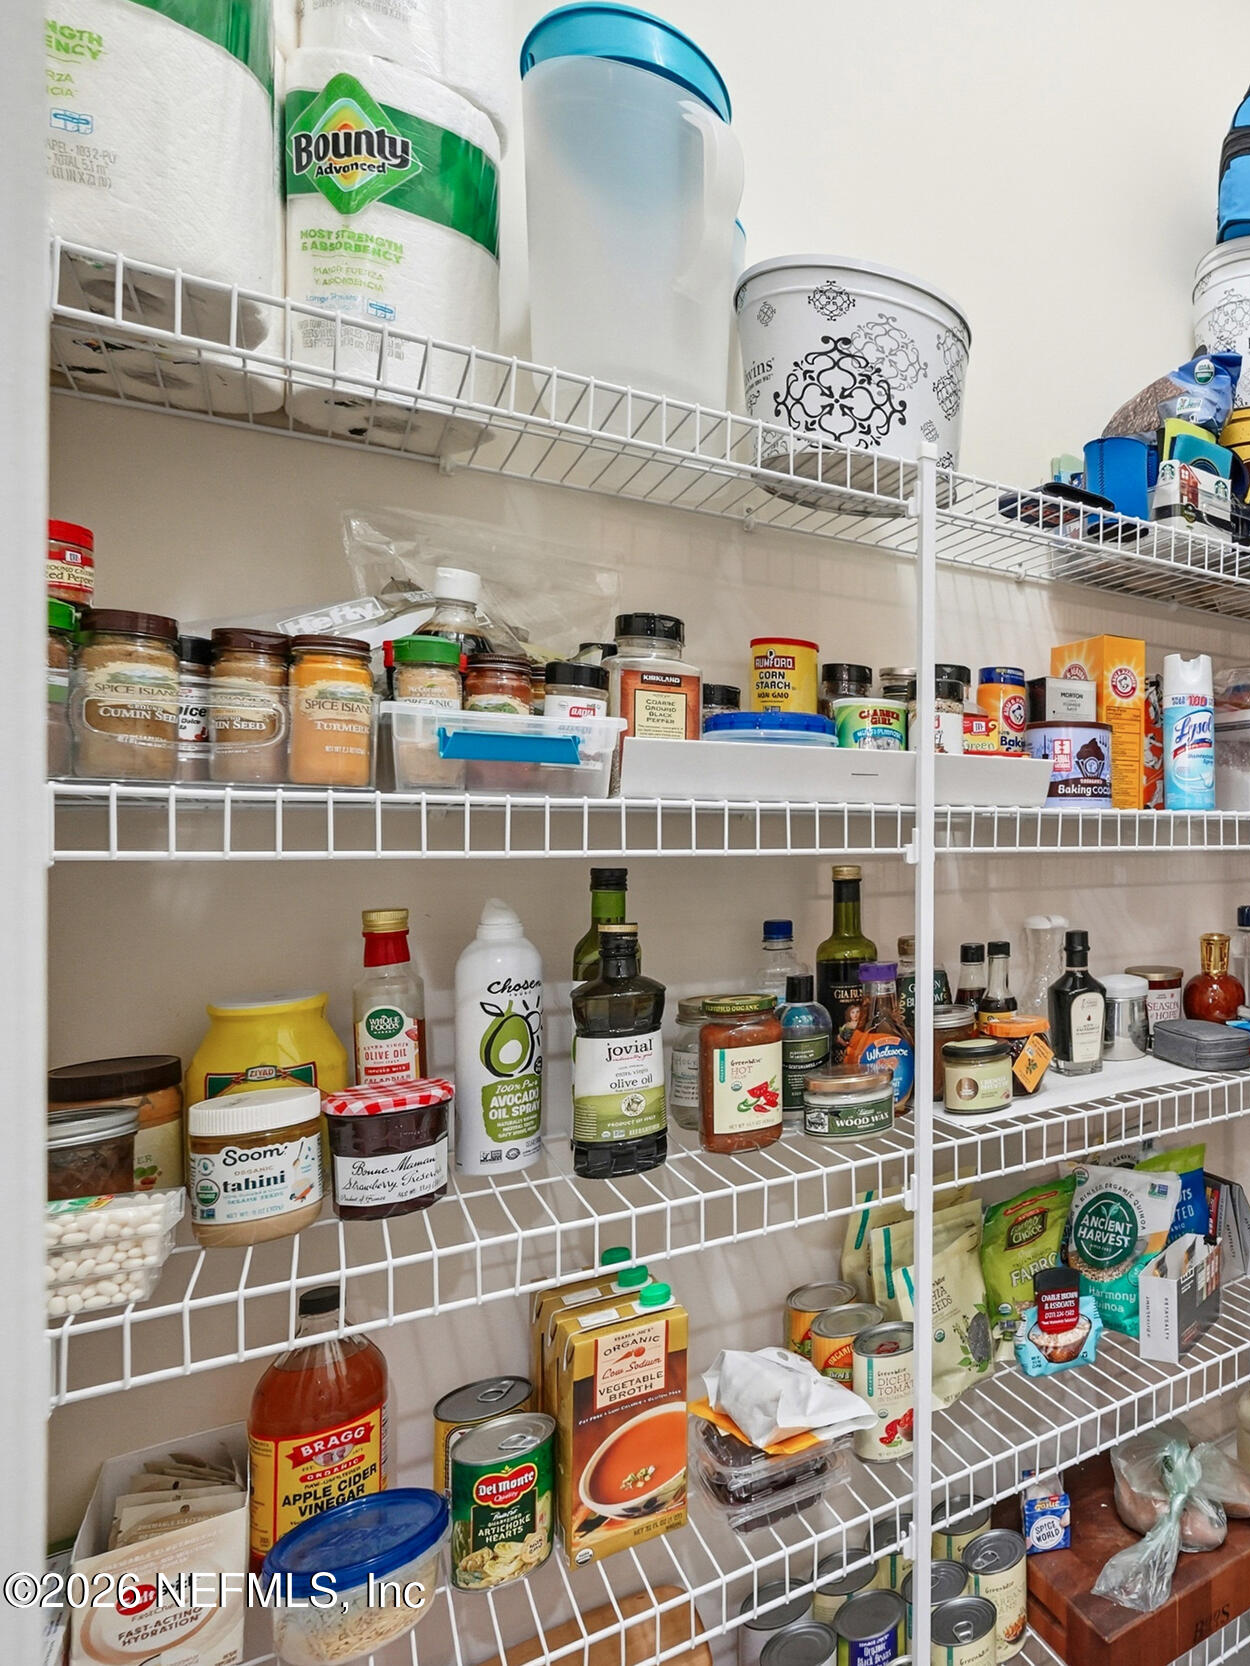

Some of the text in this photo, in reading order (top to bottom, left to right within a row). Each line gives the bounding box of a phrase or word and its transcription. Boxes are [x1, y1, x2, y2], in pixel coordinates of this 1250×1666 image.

[292, 127, 412, 175] Bounty
[315, 161, 388, 178] Advanced
[301, 228, 404, 254] MOST STRENGTH
[310, 240, 405, 264] ABSORBENCY
[754, 656, 795, 669] RUMFORD
[642, 674, 682, 684] KIRKLAND
[758, 671, 785, 681] CORN
[94, 682, 135, 694] SPICE
[755, 681, 791, 691] STARCH
[304, 698, 340, 711] SPICE
[645, 699, 677, 707] COARSE
[1060, 692, 1084, 700] MORTON
[99, 705, 151, 719] CUMIN
[645, 705, 677, 714] GROUND
[232, 719, 267, 731] SEED
[645, 717, 676, 725] PEPPER
[870, 715, 893, 726] GIRL
[1174, 713, 1214, 743] Lysol
[1057, 784, 1092, 796] Baking
[487, 978, 541, 995] Chosen
[1146, 1001, 1179, 1011] SEASON
[369, 1015, 400, 1026] WHOLE
[1155, 1010, 1178, 1020] HOPE
[370, 1022, 399, 1031] FOODS
[364, 1047, 407, 1061] OLIVE OIL
[605, 1038, 653, 1062] jovial
[249, 1067, 274, 1077] ZIYAD
[730, 1065, 754, 1075] HOT
[495, 1080, 521, 1093] 100%
[609, 1073, 653, 1090] olive oil
[489, 1087, 539, 1109] AVOCADO
[488, 1100, 540, 1121] OIL SPRAY
[835, 1112, 890, 1130] WOOD WAX
[222, 1147, 282, 1167] Soom
[351, 1154, 437, 1177] Bonne Maman
[234, 1165, 274, 1176] ORGANIC
[222, 1170, 286, 1193] tahini
[342, 1177, 398, 1192] Strawberry
[1080, 1213, 1133, 1233] ANCIENT
[1077, 1227, 1131, 1248] HARVEST
[1089, 1286, 1137, 1304] Harmony
[603, 1335, 661, 1357] ORGANIC
[601, 1357, 663, 1380] Low Sodium
[598, 1370, 664, 1396] VEGETABLE
[877, 1372, 911, 1387] DICED
[608, 1383, 653, 1402] BROTH
[300, 1426, 366, 1457] BRAGG
[307, 1458, 359, 1481] ORGANIC
[281, 1462, 378, 1508] APPLE CIDER
[478, 1470, 535, 1496] Del Monte
[298, 1483, 366, 1518] VINEGAR
[494, 1491, 519, 1503] Quality
[478, 1514, 532, 1537] ARTICHOKE
[1034, 1521, 1057, 1537] SPICE
[485, 1526, 524, 1543] HEARTS
[1035, 1526, 1061, 1543] WORLD
[121, 1613, 200, 1648] HYDRATION
